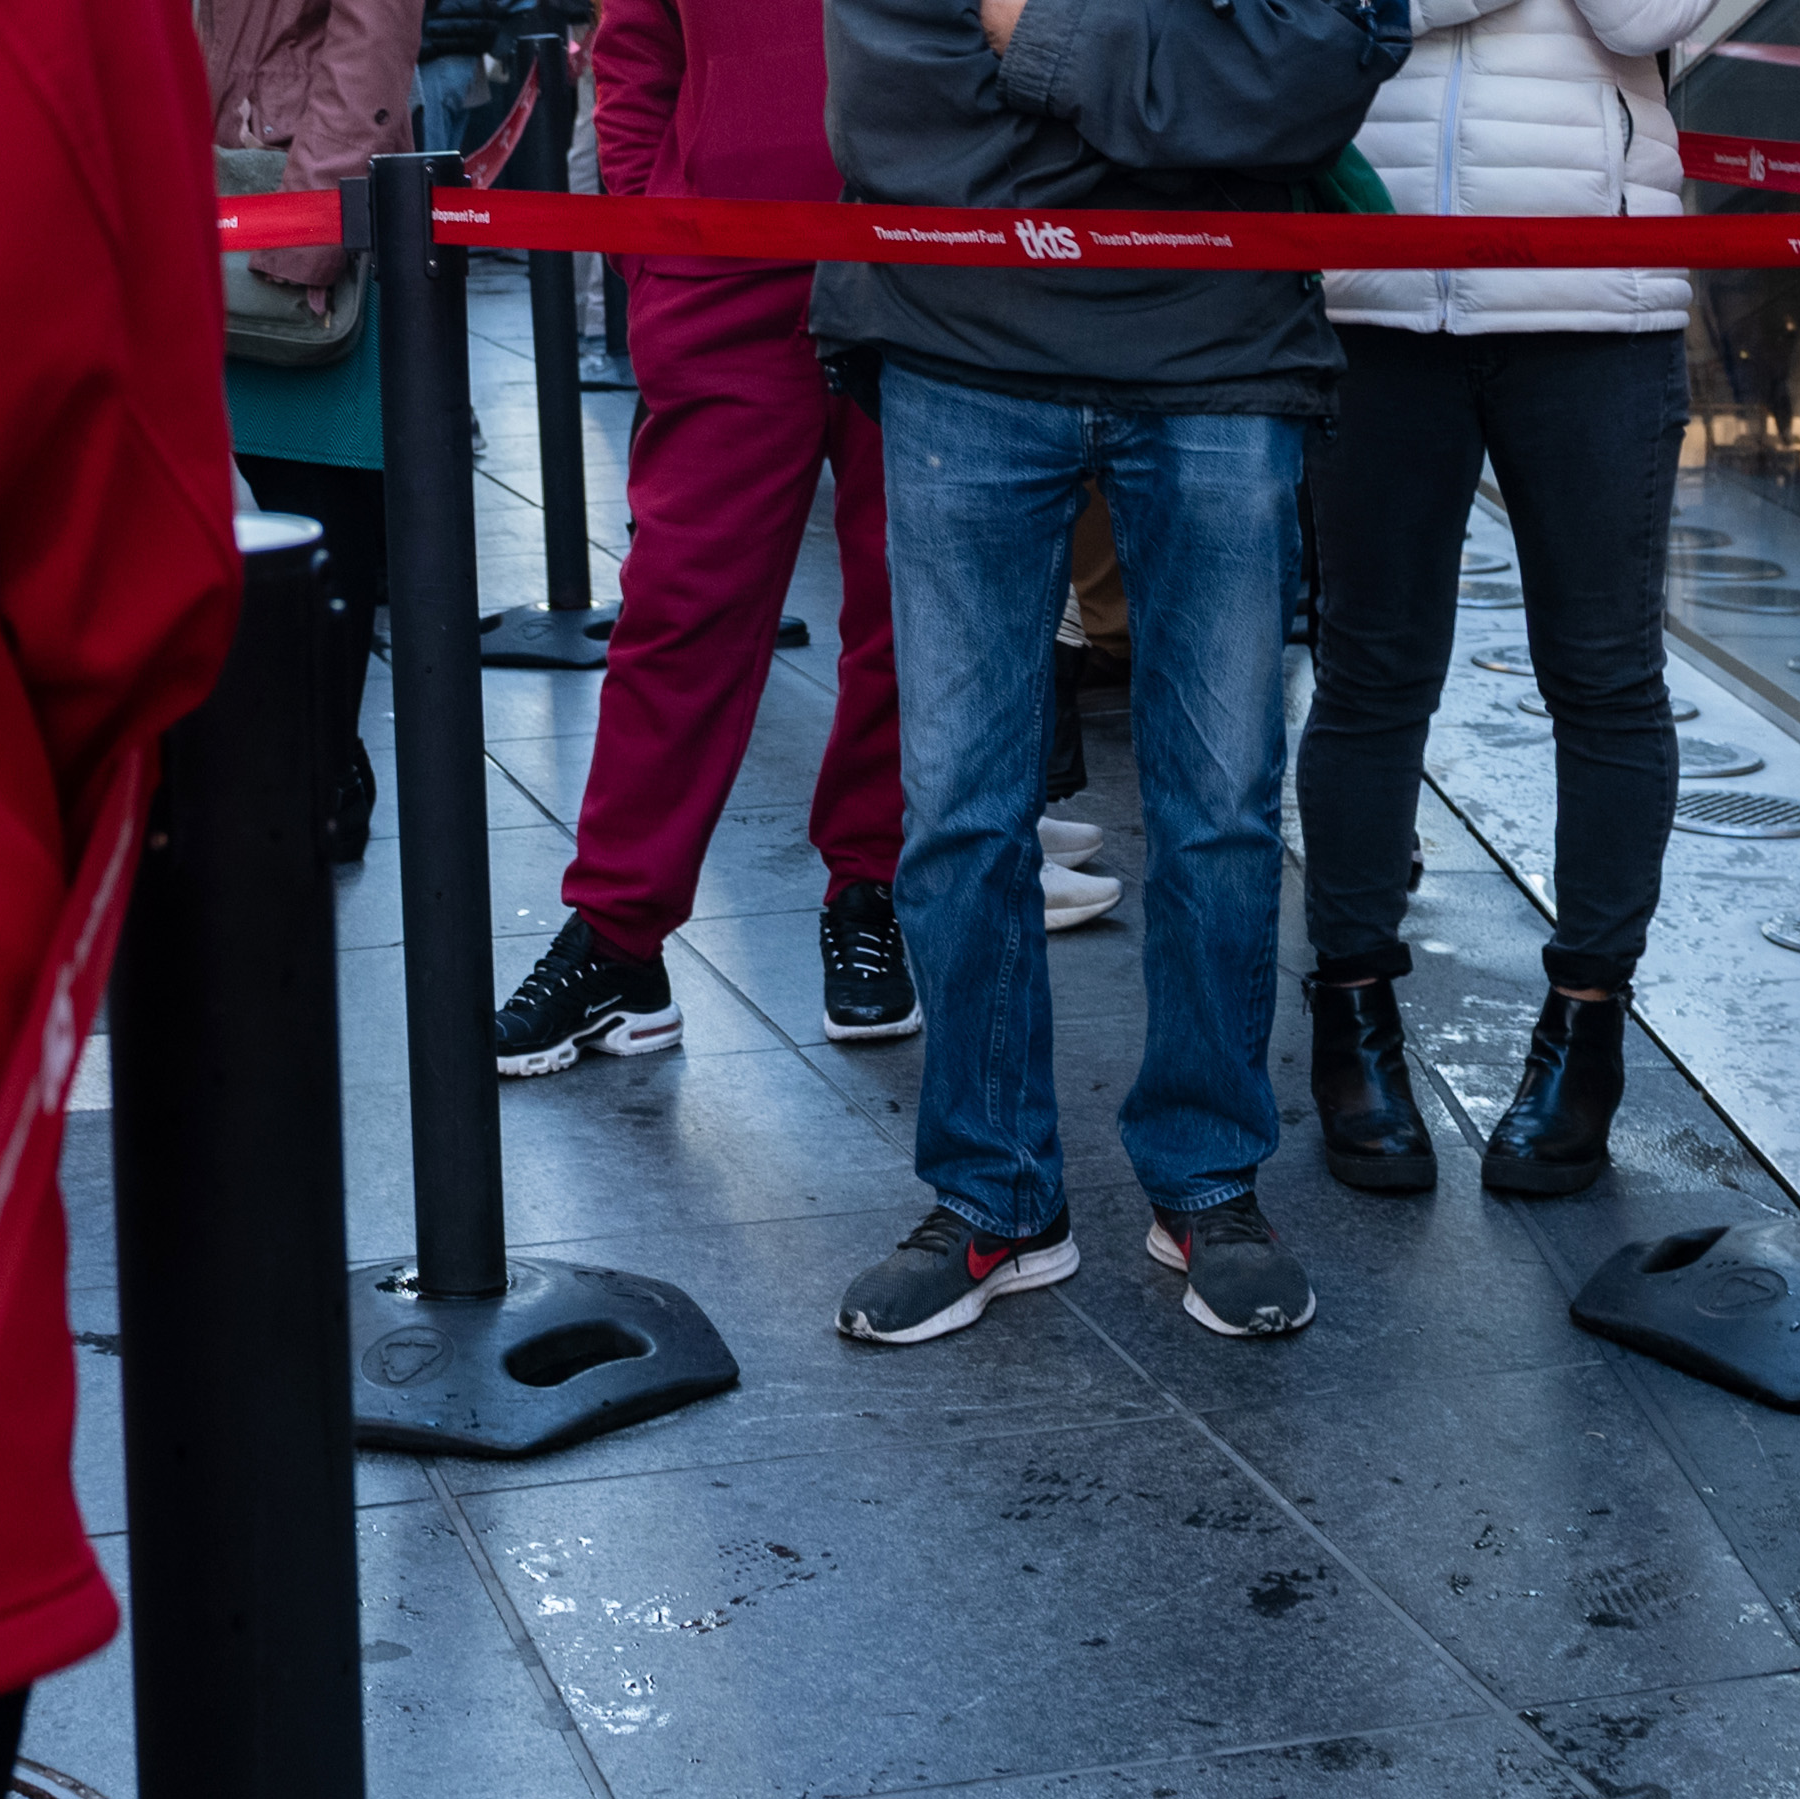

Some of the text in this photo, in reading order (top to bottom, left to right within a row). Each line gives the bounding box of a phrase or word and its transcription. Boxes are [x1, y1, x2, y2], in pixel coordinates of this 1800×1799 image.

[468, 209, 491, 225] Fund
[872, 218, 1234, 260] Theatre Development Fund tkts Theatre Development Fund
